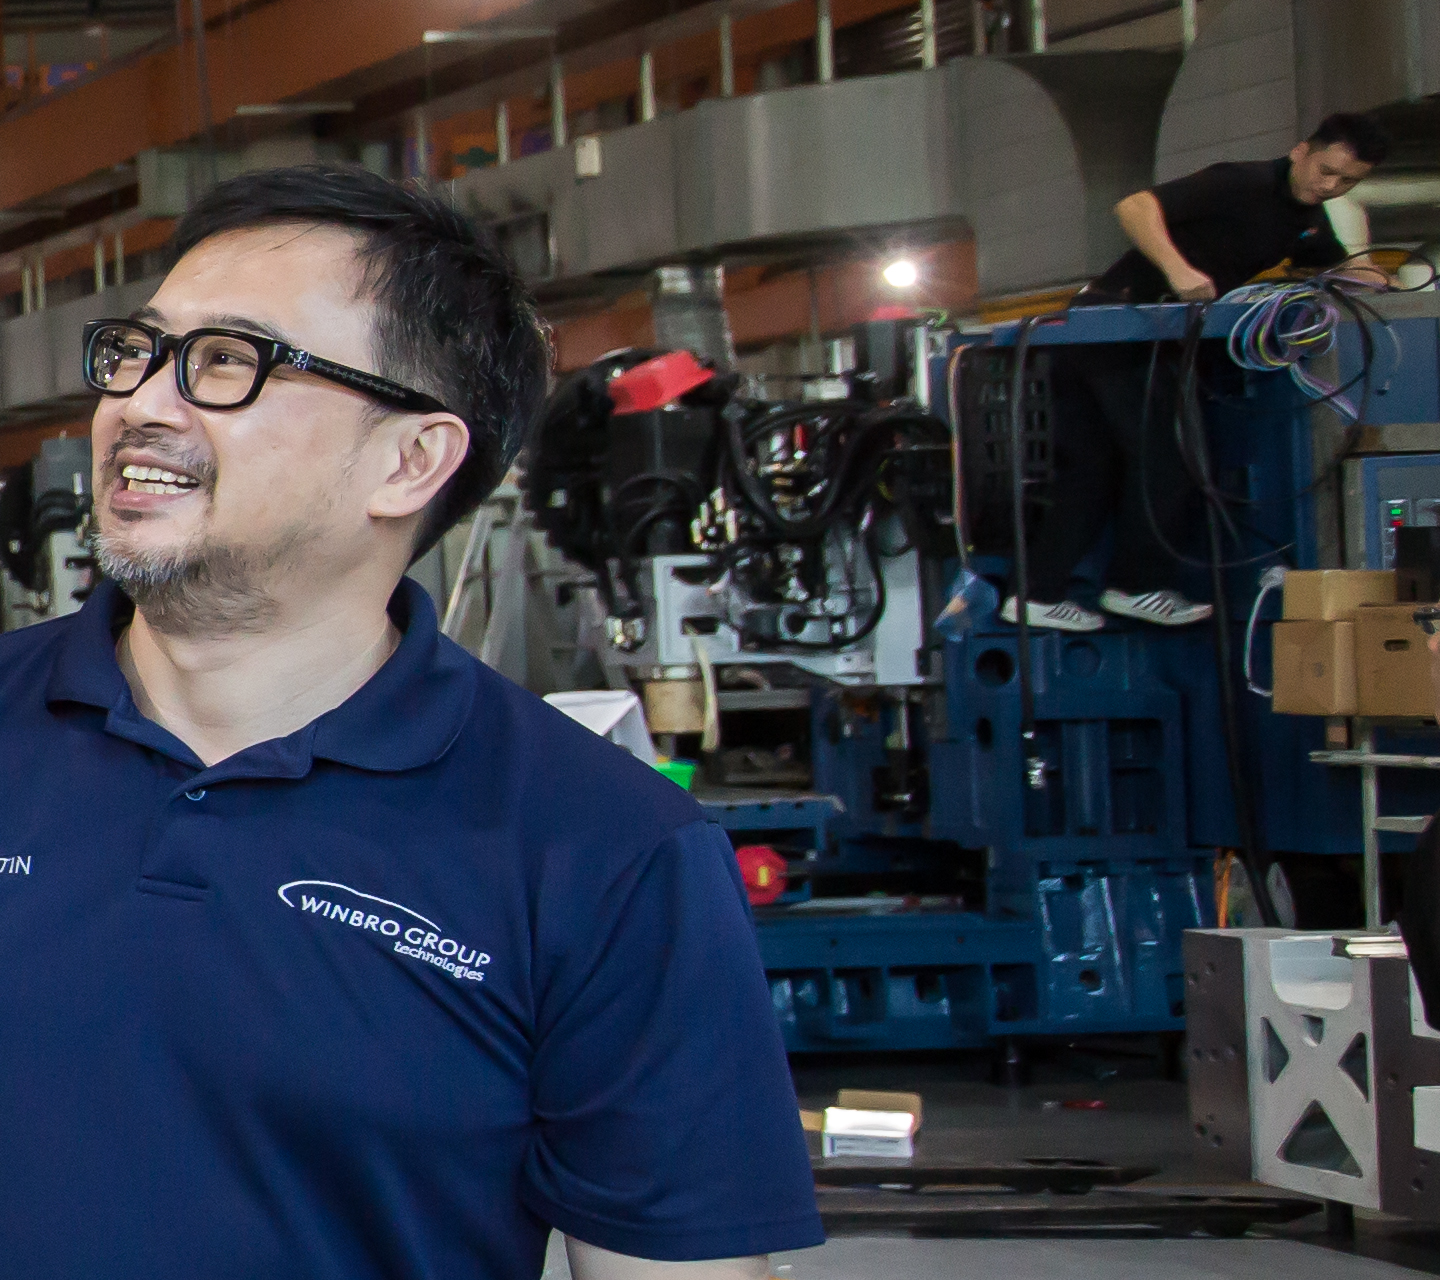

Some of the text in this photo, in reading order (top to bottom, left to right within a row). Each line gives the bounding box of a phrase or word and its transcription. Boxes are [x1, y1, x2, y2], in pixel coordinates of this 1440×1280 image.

[301, 894, 492, 968] WINBRO GROUP
[393, 940, 485, 982] technologies
